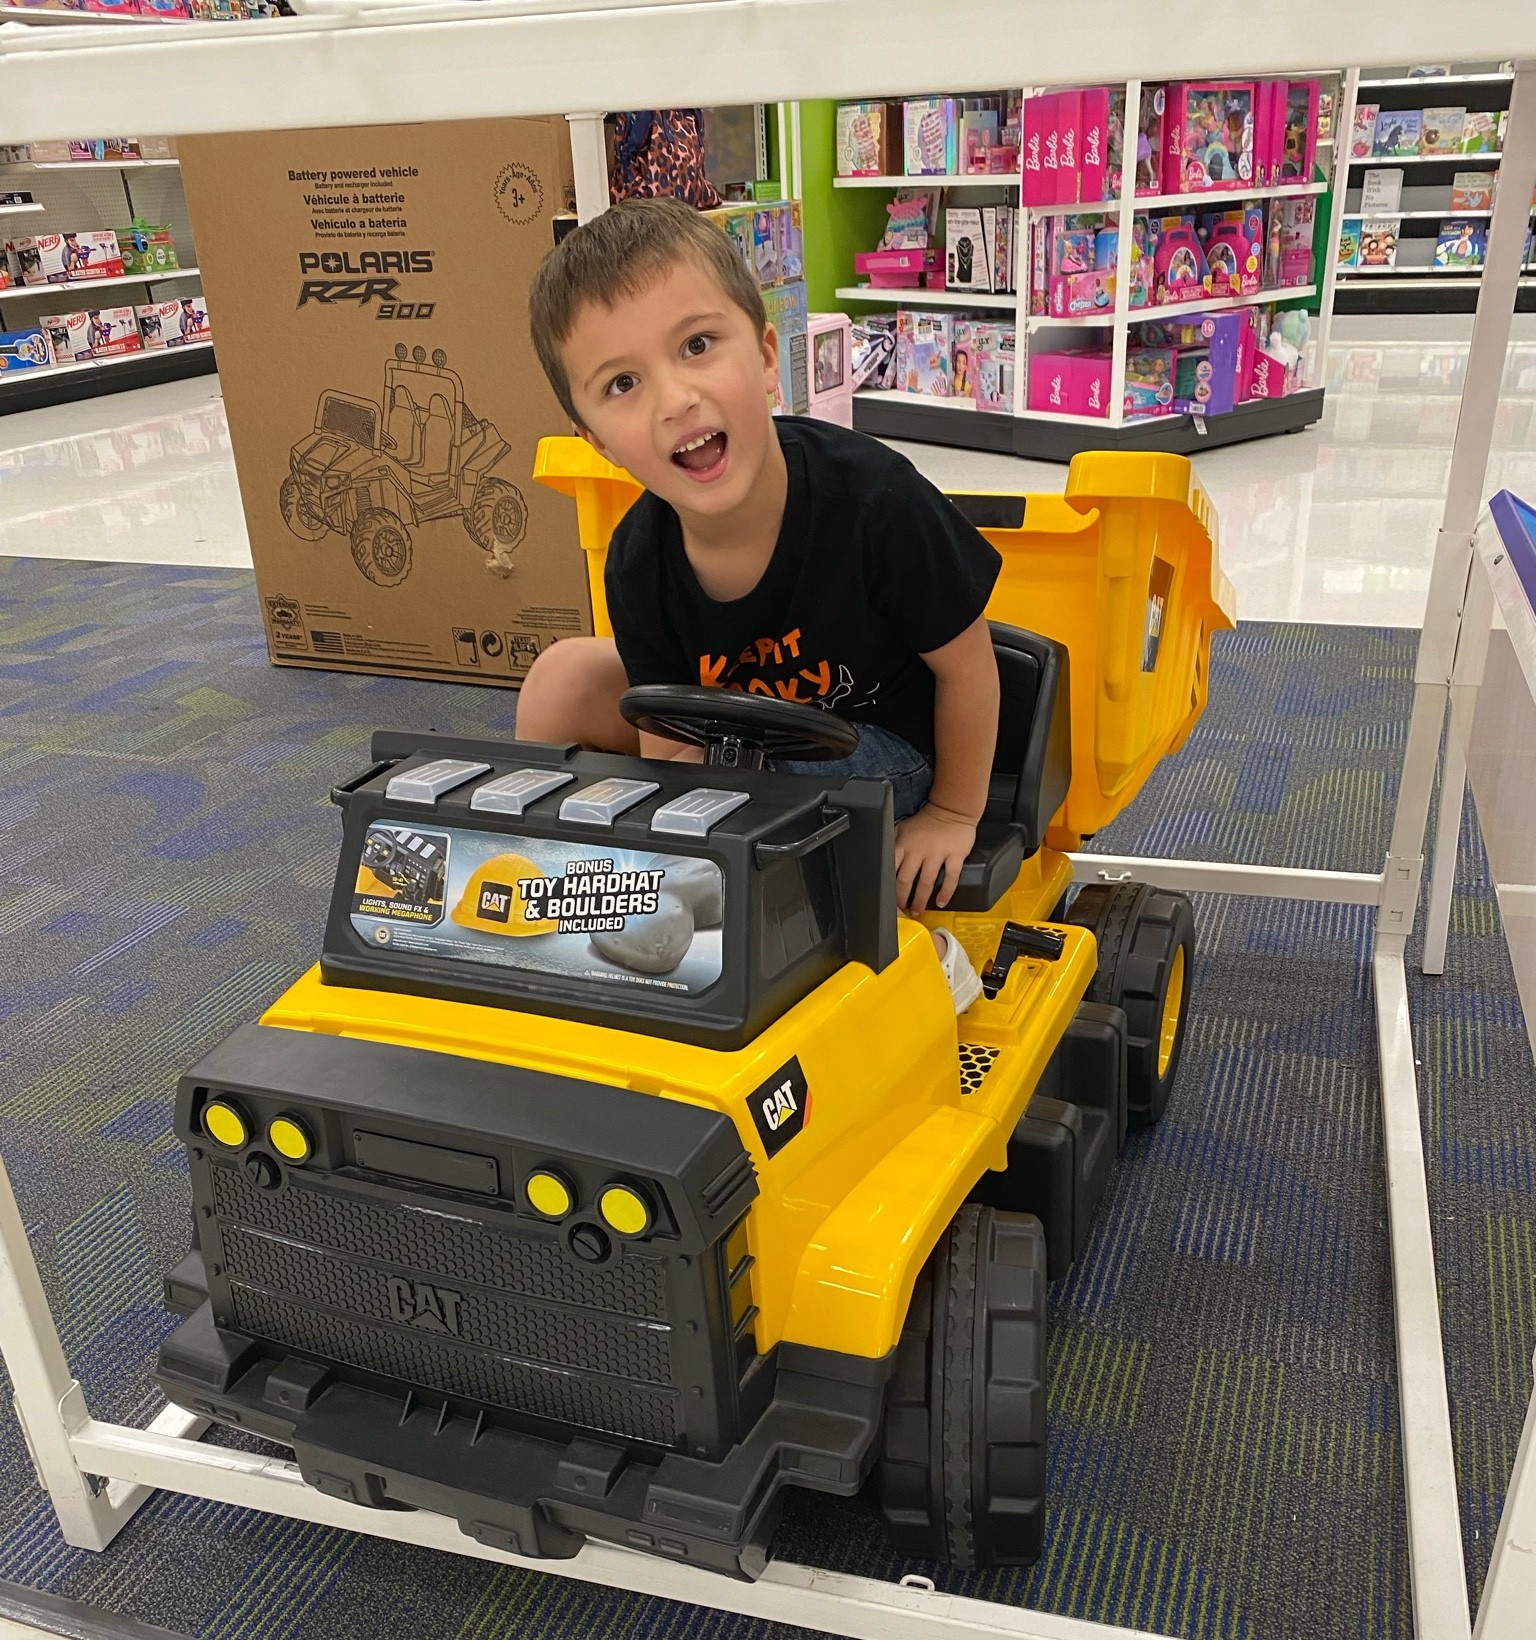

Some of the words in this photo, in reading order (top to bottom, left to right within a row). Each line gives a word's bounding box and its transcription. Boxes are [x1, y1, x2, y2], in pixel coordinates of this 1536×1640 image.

[1026, 132, 1040, 171] Barbie
[1044, 130, 1058, 170] Barbie
[1060, 128, 1075, 168] Barbie
[1084, 126, 1100, 166] Barbie
[288, 170, 327, 182] Battery
[330, 168, 376, 181] powered
[379, 166, 418, 178] vehicle
[303, 193, 350, 205] Véhicule
[352, 194, 360, 204] à
[362, 192, 405, 204] batterie
[512, 188, 526, 208] 3+
[359, 220, 366, 228] a
[38, 235, 60, 250] NERF
[299, 250, 433, 274] POLARIS
[296, 276, 402, 310] RZR
[66, 314, 86, 329] NERF
[158, 302, 178, 318] NERF
[375, 302, 436, 320] 900
[1203, 324, 1212, 332] 10
[1250, 358, 1269, 396] Barbie
[1050, 374, 1061, 405] Barbie
[1088, 378, 1100, 409] Barbie
[700, 637, 774, 688] KEP
[567, 860, 612, 874] BONUS
[518, 877, 558, 898] TOY
[563, 870, 664, 896] HARDHAT
[359, 904, 390, 916] WORKING
[392, 908, 432, 922] MEGAPHONE
[362, 898, 387, 908] LIGHTS,
[389, 901, 412, 912] SOUND
[413, 904, 422, 912] FX
[424, 906, 429, 914] &
[481, 891, 510, 913] CAT
[525, 900, 540, 919] &
[547, 893, 657, 918] BOULDERS
[558, 917, 623, 932] INCLUDED
[762, 1079, 798, 1131] CAT
[387, 1275, 463, 1338] CAT
